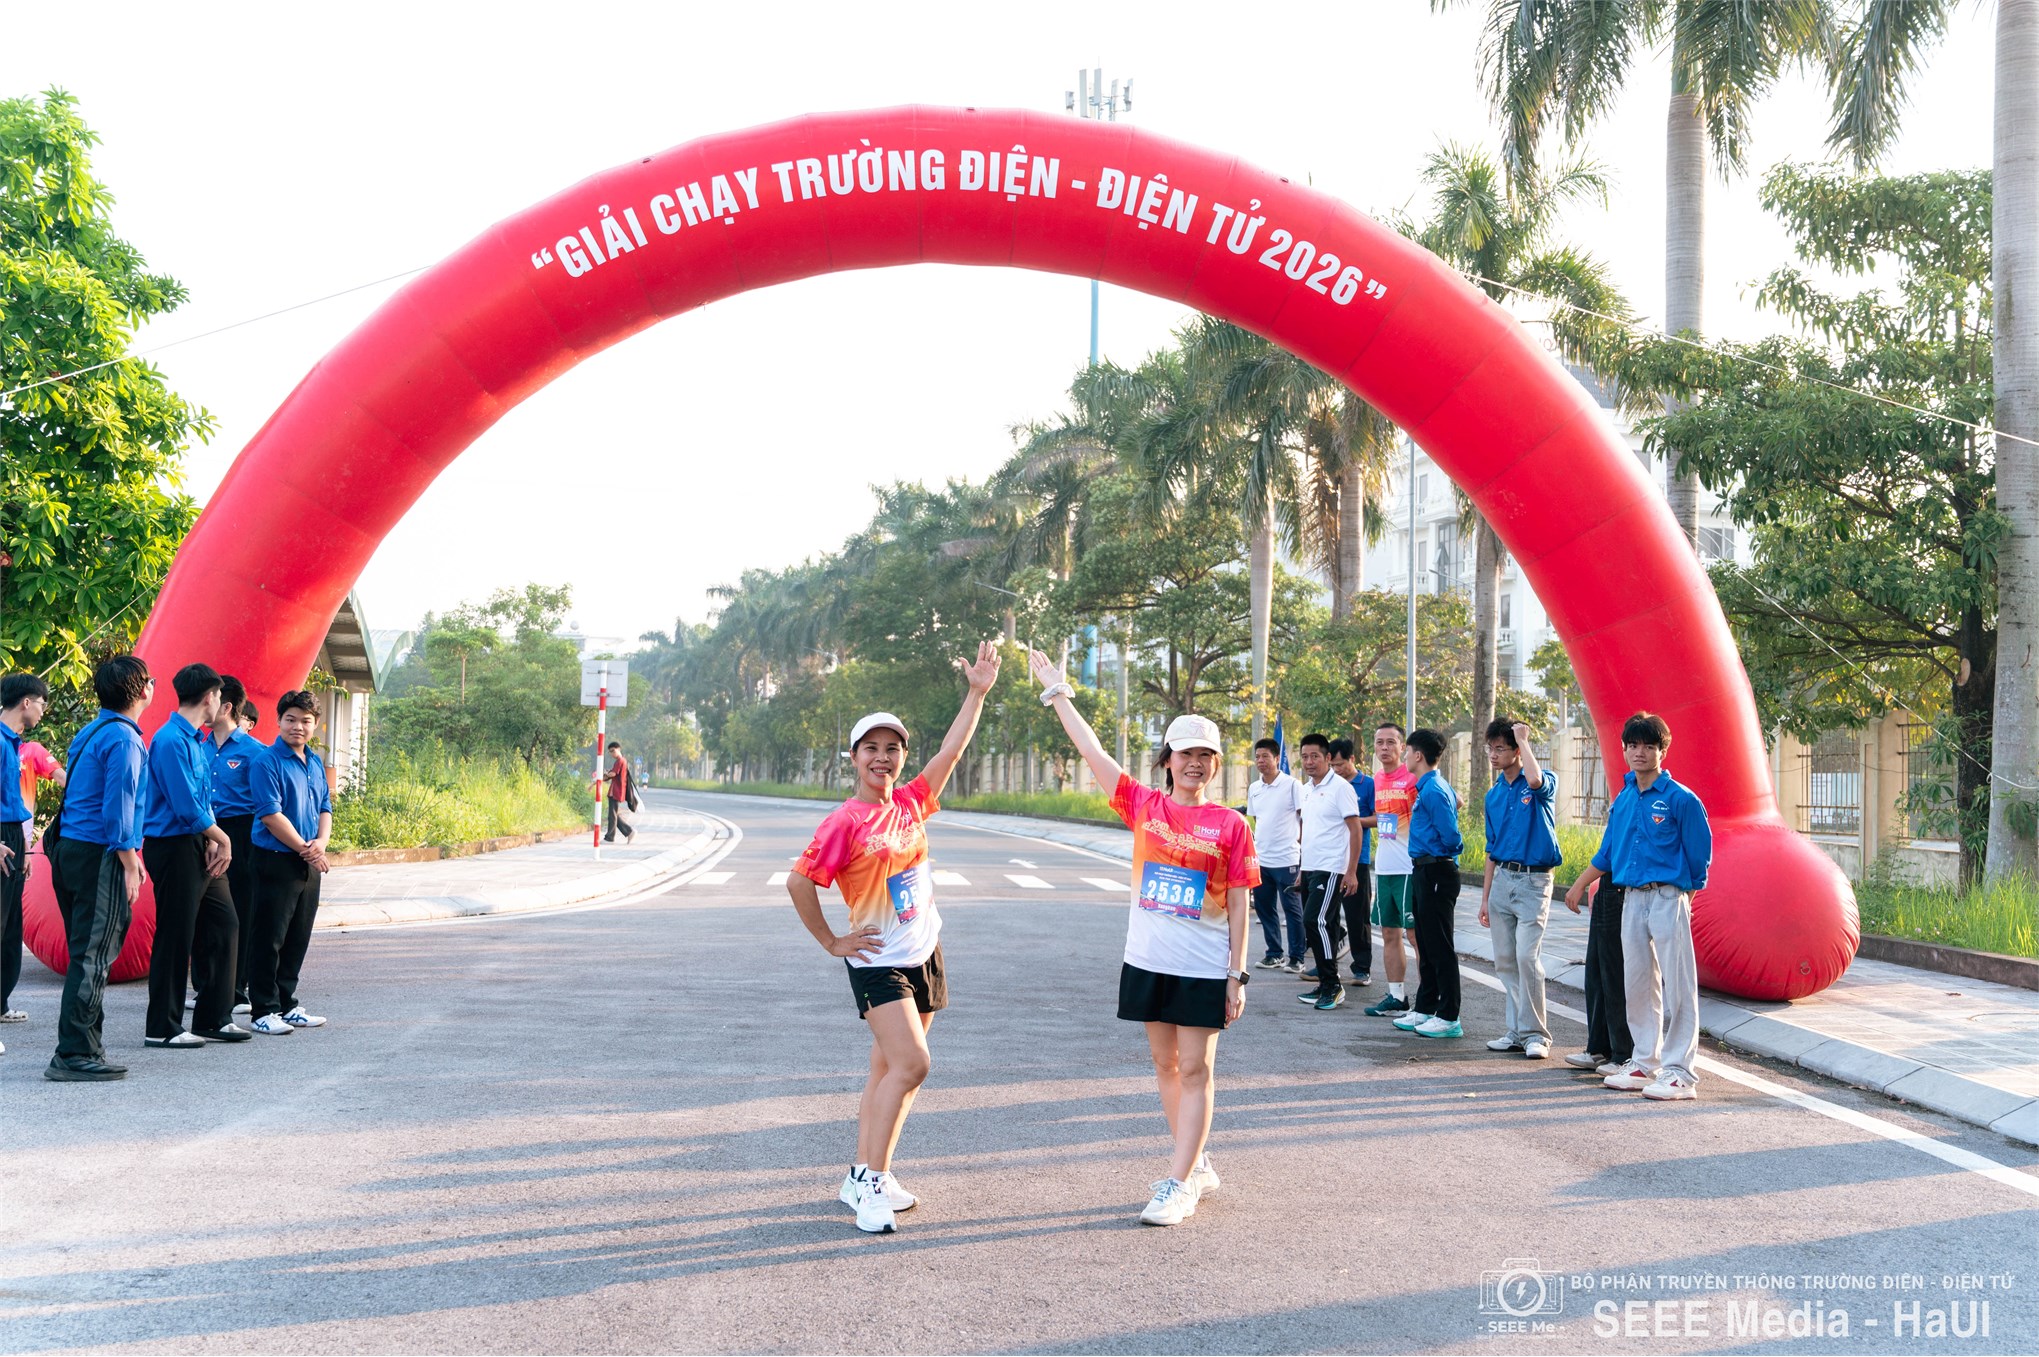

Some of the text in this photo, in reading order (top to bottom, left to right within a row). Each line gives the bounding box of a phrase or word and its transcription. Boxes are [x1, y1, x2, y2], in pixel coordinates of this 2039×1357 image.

[531, 138, 1387, 306] “GIẢI CHẠY TRƯỜNG ĐIỆN - ĐIỆN TỬ 2026”
[1201, 826, 1220, 836] HaUI
[1147, 880, 1195, 905] 2538
